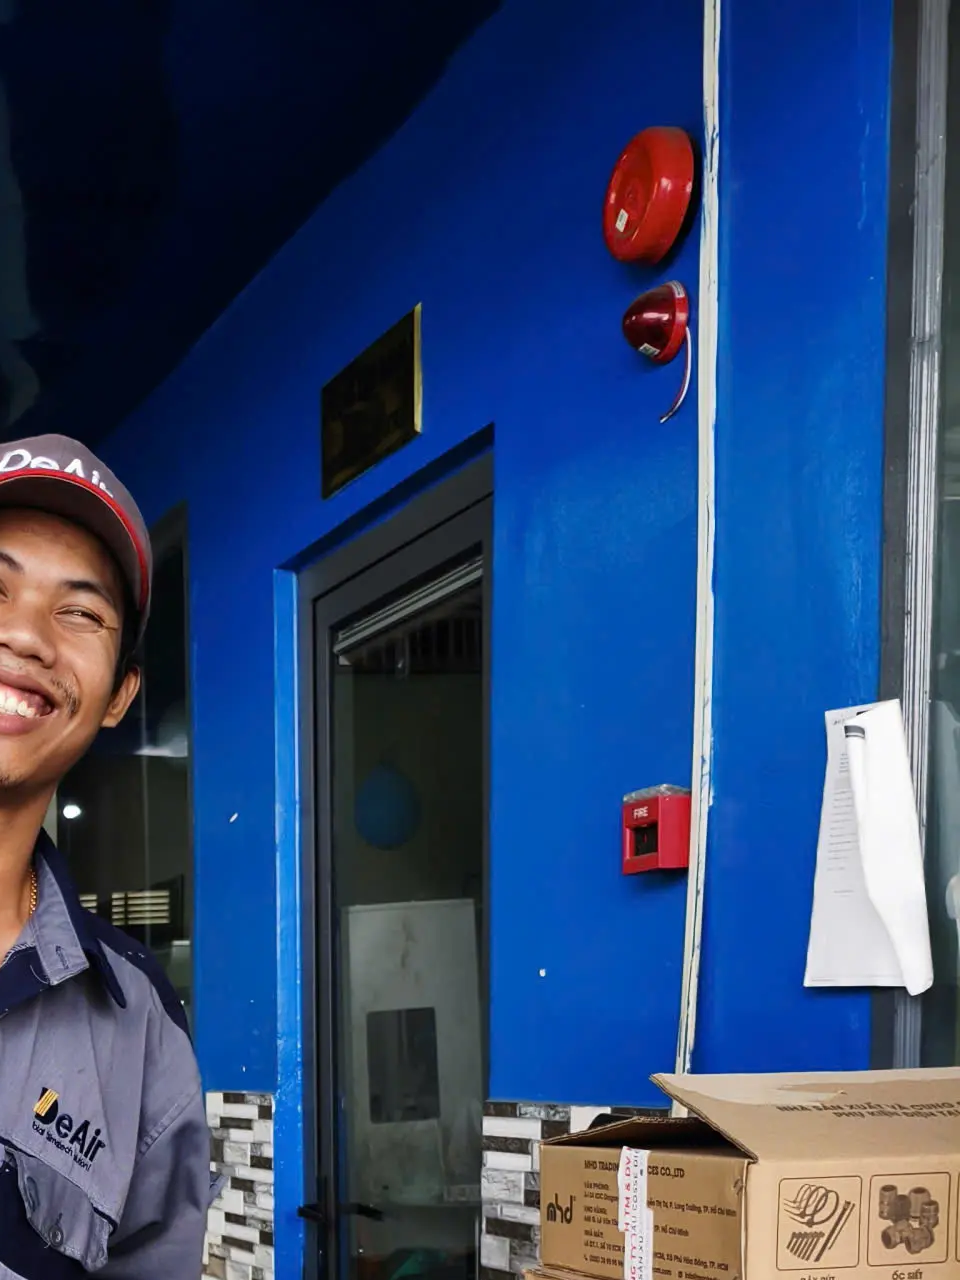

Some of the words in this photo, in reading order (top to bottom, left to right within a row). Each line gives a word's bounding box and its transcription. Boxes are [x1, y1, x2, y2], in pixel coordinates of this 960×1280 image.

[633, 806, 649, 819] FIRE
[598, 1161, 619, 1172] TRADIN
[647, 1165, 659, 1176] CES
[891, 1270, 905, 1280] ỐC
[907, 1268, 923, 1280] SIẾT
